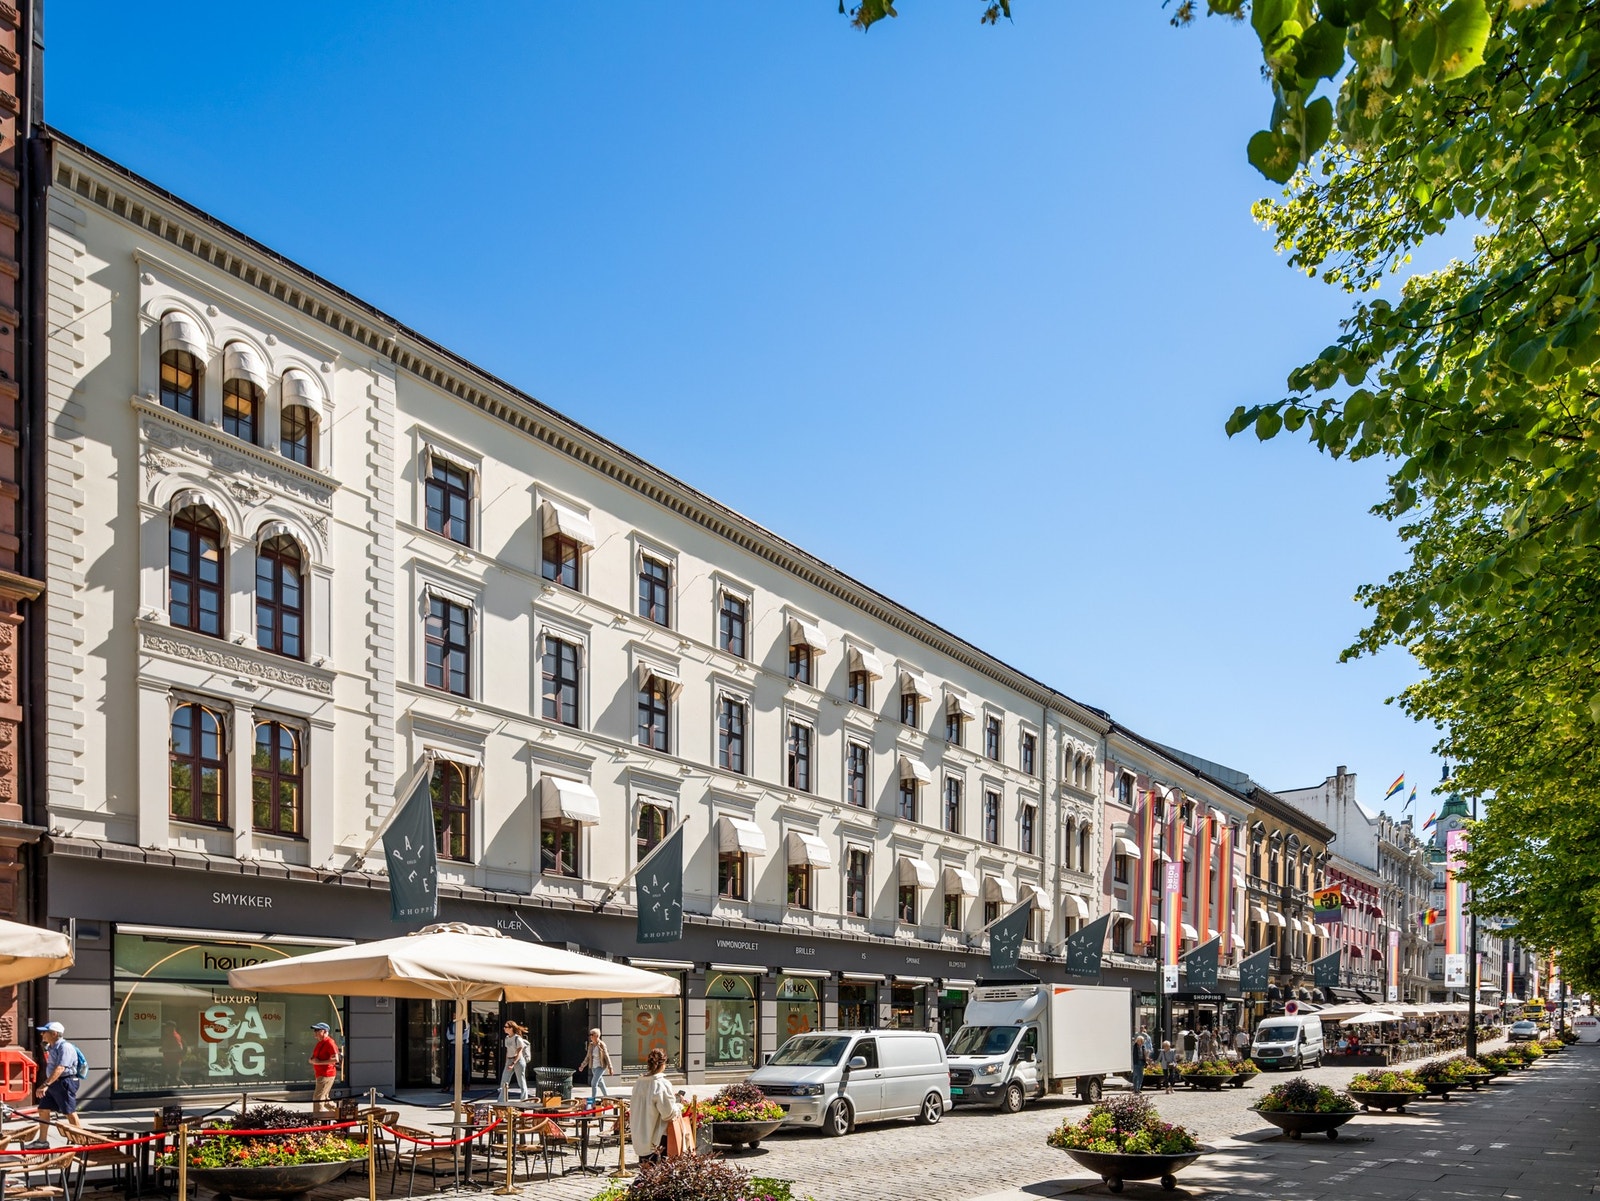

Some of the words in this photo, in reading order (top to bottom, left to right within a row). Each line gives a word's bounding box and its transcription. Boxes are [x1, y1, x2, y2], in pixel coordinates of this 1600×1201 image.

[212, 891, 273, 908] SMYKKER
[497, 919, 522, 930] KLÆR
[716, 939, 759, 951] VINMONOPOLET
[795, 947, 815, 955] BRILLER
[214, 996, 258, 1004] LUXURY
[133, 1012, 157, 1021] 30%
[204, 1005, 268, 1040] SA
[262, 1013, 282, 1021] 40%
[636, 1011, 669, 1037] SA
[718, 1013, 745, 1036] SA
[787, 1014, 810, 1035] SA
[719, 1036, 744, 1059] LG
